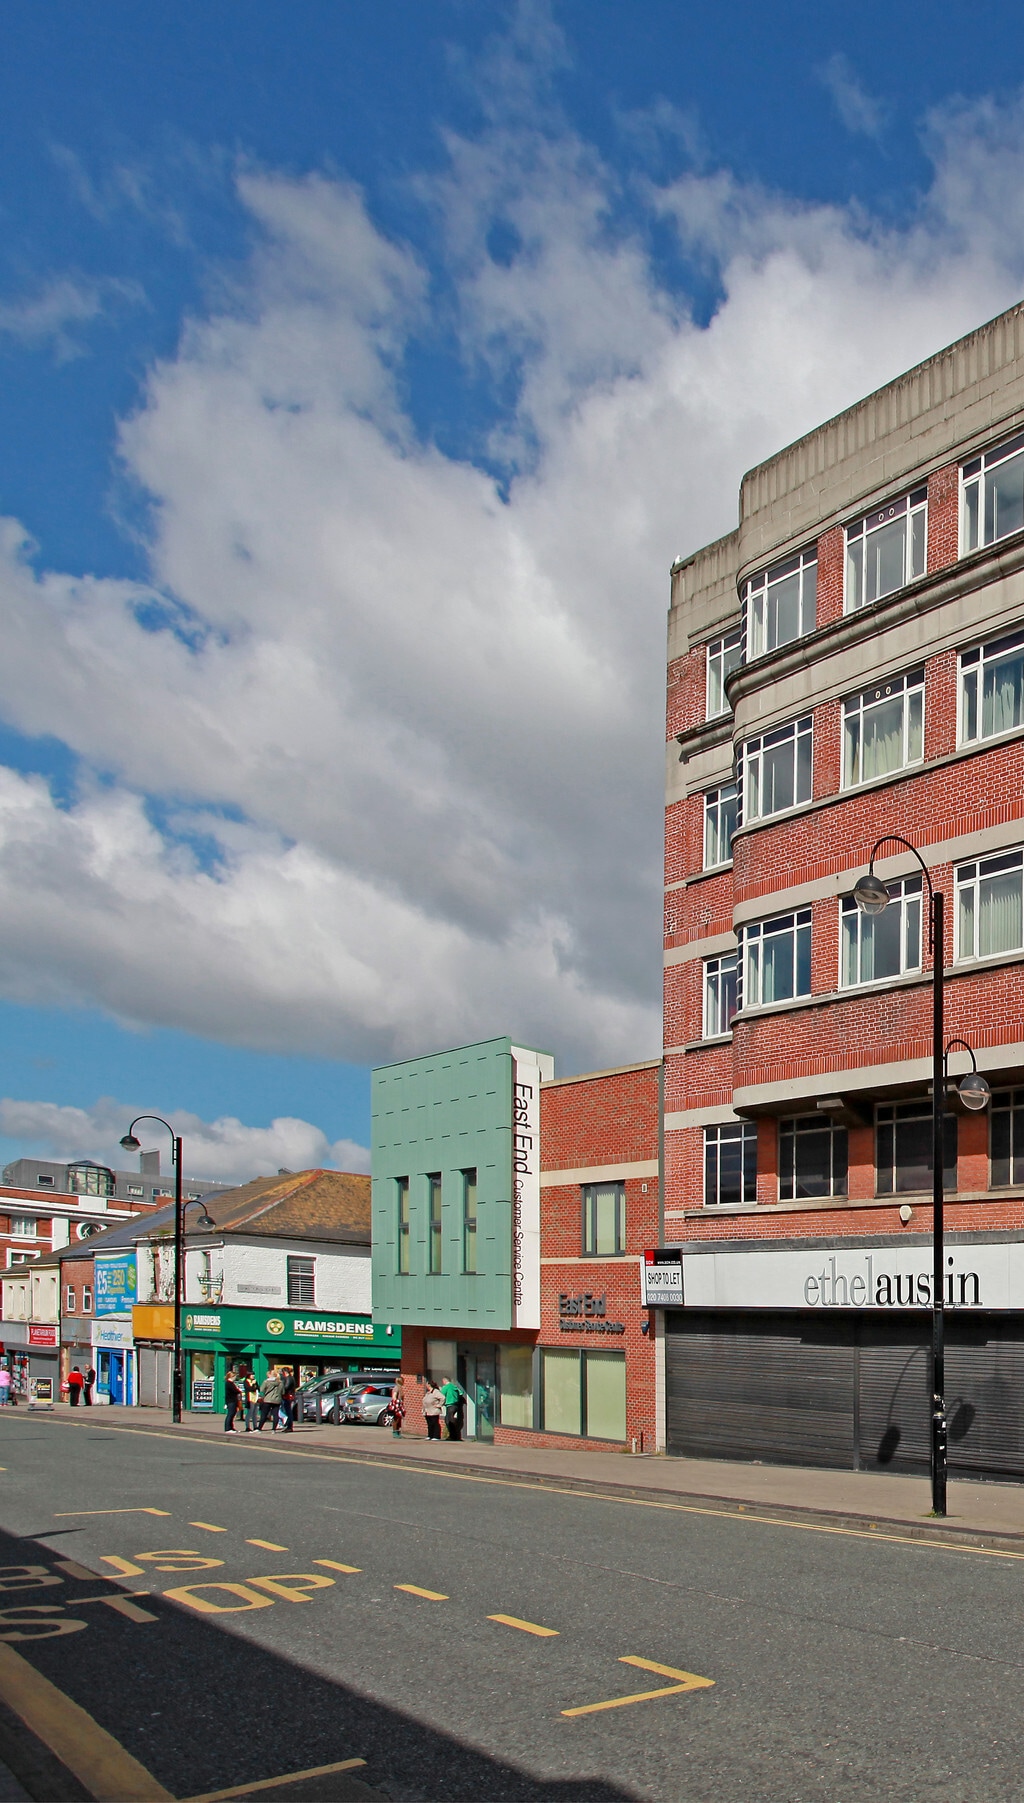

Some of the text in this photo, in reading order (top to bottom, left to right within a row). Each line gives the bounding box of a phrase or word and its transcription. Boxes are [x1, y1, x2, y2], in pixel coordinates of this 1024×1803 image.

[513, 1082, 533, 1306] East End Customer Service Centre
[97, 1269, 108, 1295] £5
[647, 1272, 681, 1285] SHOP TO LET
[803, 1254, 983, 1307] ethelausin
[559, 1293, 607, 1316] East End
[646, 1293, 657, 1302] 020
[193, 1314, 221, 1326] RAMSDENS
[293, 1319, 374, 1335] RAMSDENS
[0, 1550, 226, 1592] BUS
[0, 1574, 337, 1642] STOP
